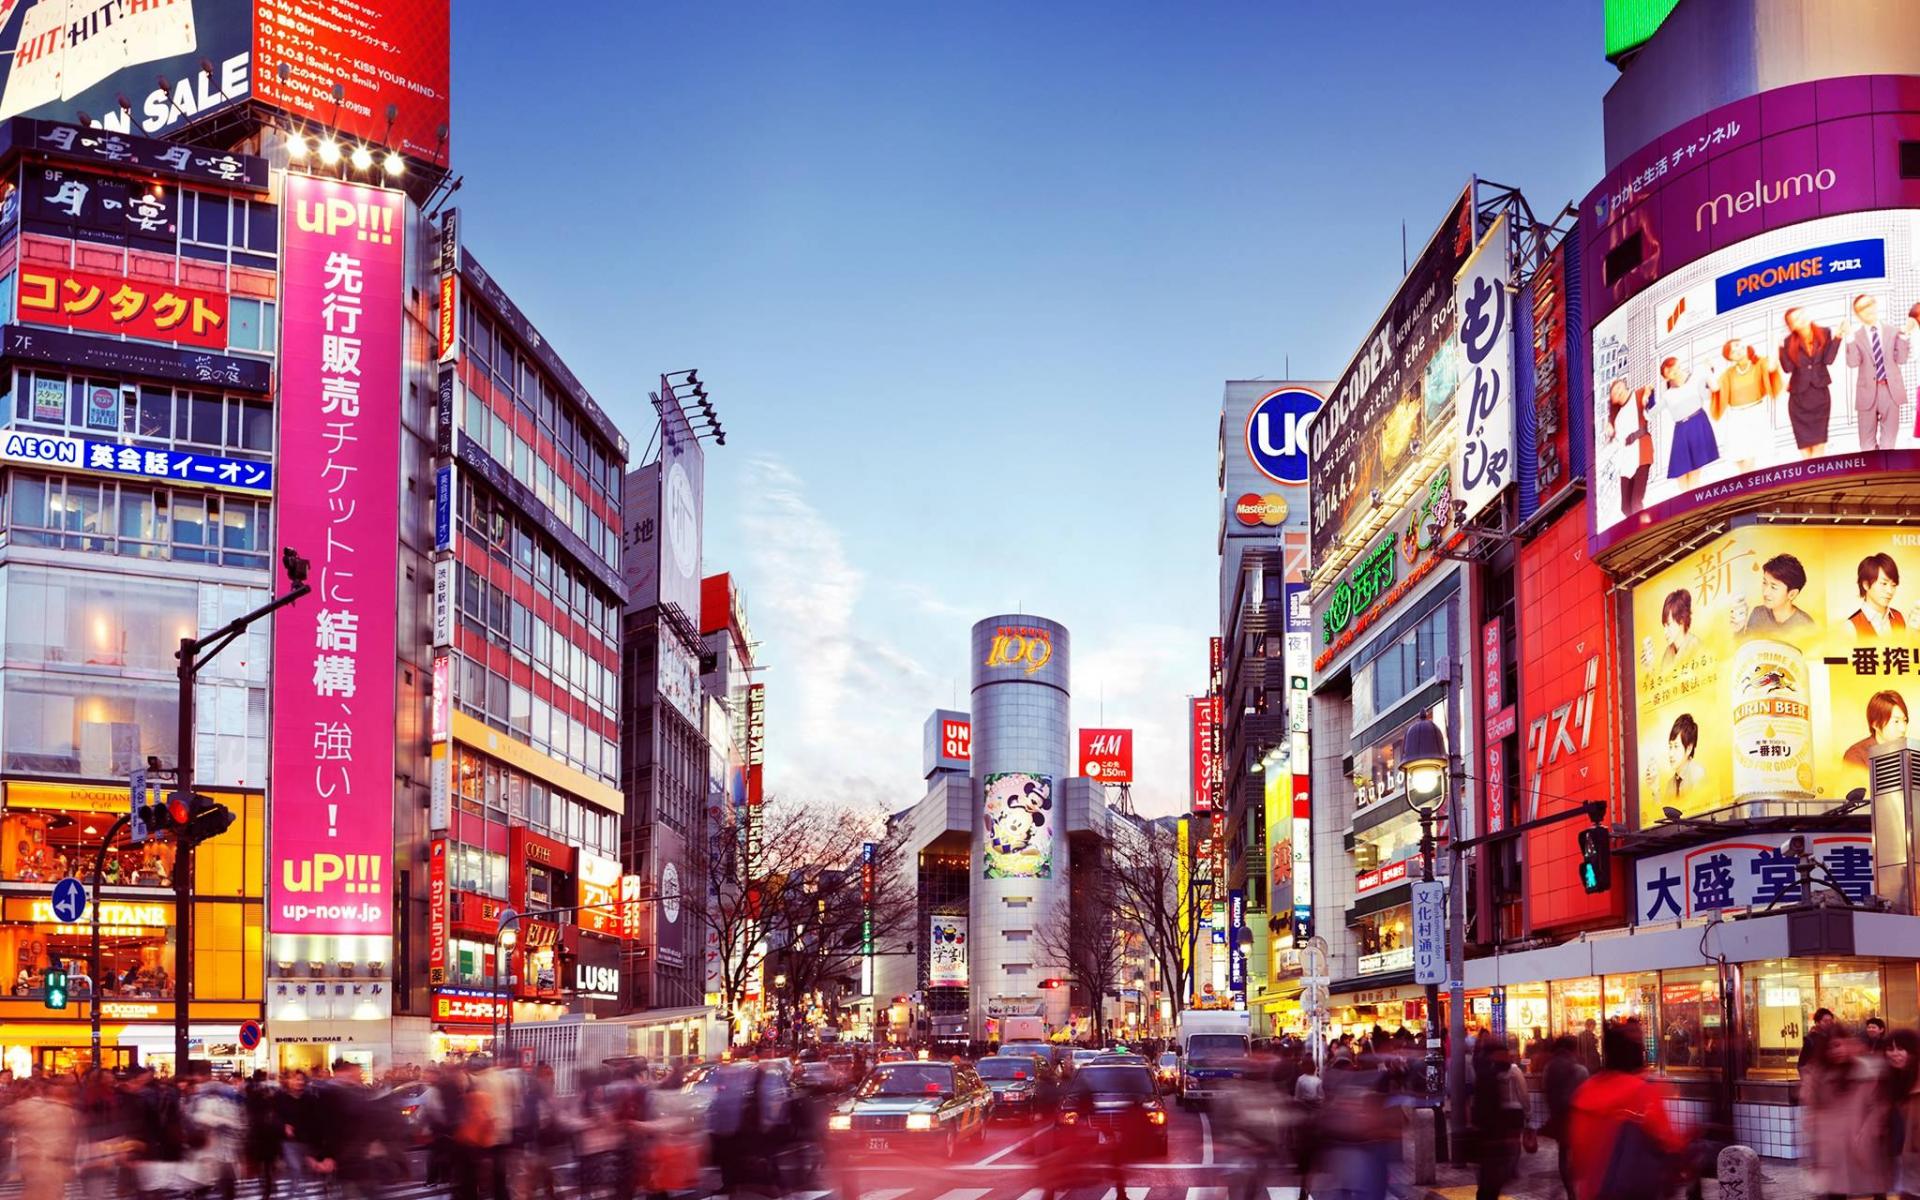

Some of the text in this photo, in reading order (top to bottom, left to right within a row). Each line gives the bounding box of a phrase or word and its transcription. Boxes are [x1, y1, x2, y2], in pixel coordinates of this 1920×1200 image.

[258, 8, 275, 22] 09.
[277, 1, 293, 14] My
[294, 6, 343, 32] Resistance
[258, 53, 275, 67] 12.
[258, 68, 275, 82] 13.
[259, 22, 275, 37] 10.
[353, 58, 376, 75] KISS
[378, 69, 405, 88] YOUR
[407, 80, 435, 98] MIND
[259, 38, 275, 51] 11.
[305, 55, 334, 75] (Smile
[336, 68, 350, 80] On
[352, 73, 381, 93] Smile)
[142, 51, 250, 133] SALE
[258, 83, 315, 112] 14. Luv Sick
[44, 170, 63, 181] 9F
[1611, 120, 1741, 211] わかさ生活 チャンネル
[43, 181, 168, 231] 月の宴
[1695, 168, 1837, 232] melumo
[296, 199, 393, 245] uP!!!
[1735, 256, 1862, 297] PROMISE プロミス
[21, 274, 222, 334] コンタクト
[14, 335, 33, 350] 7F
[526, 324, 541, 349] 9F
[1312, 281, 1436, 462] OLDCODEX NEW ALBUM
[1461, 275, 1510, 492] もんじゃ
[1316, 473, 1323, 489] A
[1363, 370, 1400, 427] within
[1404, 337, 1425, 371] the
[7, 435, 266, 485] AEON 英会話イーオン
[1314, 460, 1357, 536] 2014.4.2
[1695, 457, 1867, 503] WAKASA SEIKATSU CHANNEL
[1235, 503, 1288, 516] MasterCard
[434, 658, 448, 668] 5F
[984, 633, 1053, 676] 109
[1735, 701, 1807, 719] KIRIN BEER
[1089, 734, 1122, 756] H&M
[1749, 745, 1792, 757] 一番搾り
[1102, 769, 1127, 778] 150m
[526, 842, 551, 862] COFFEE
[283, 854, 382, 893] uP!!!
[1647, 846, 1875, 922] 大盛堂書
[283, 903, 382, 922] up-now.jp
[1233, 897, 1242, 928] MIZUHO
[1417, 890, 1433, 968] 文化村通り
[576, 963, 619, 993] LUSH
